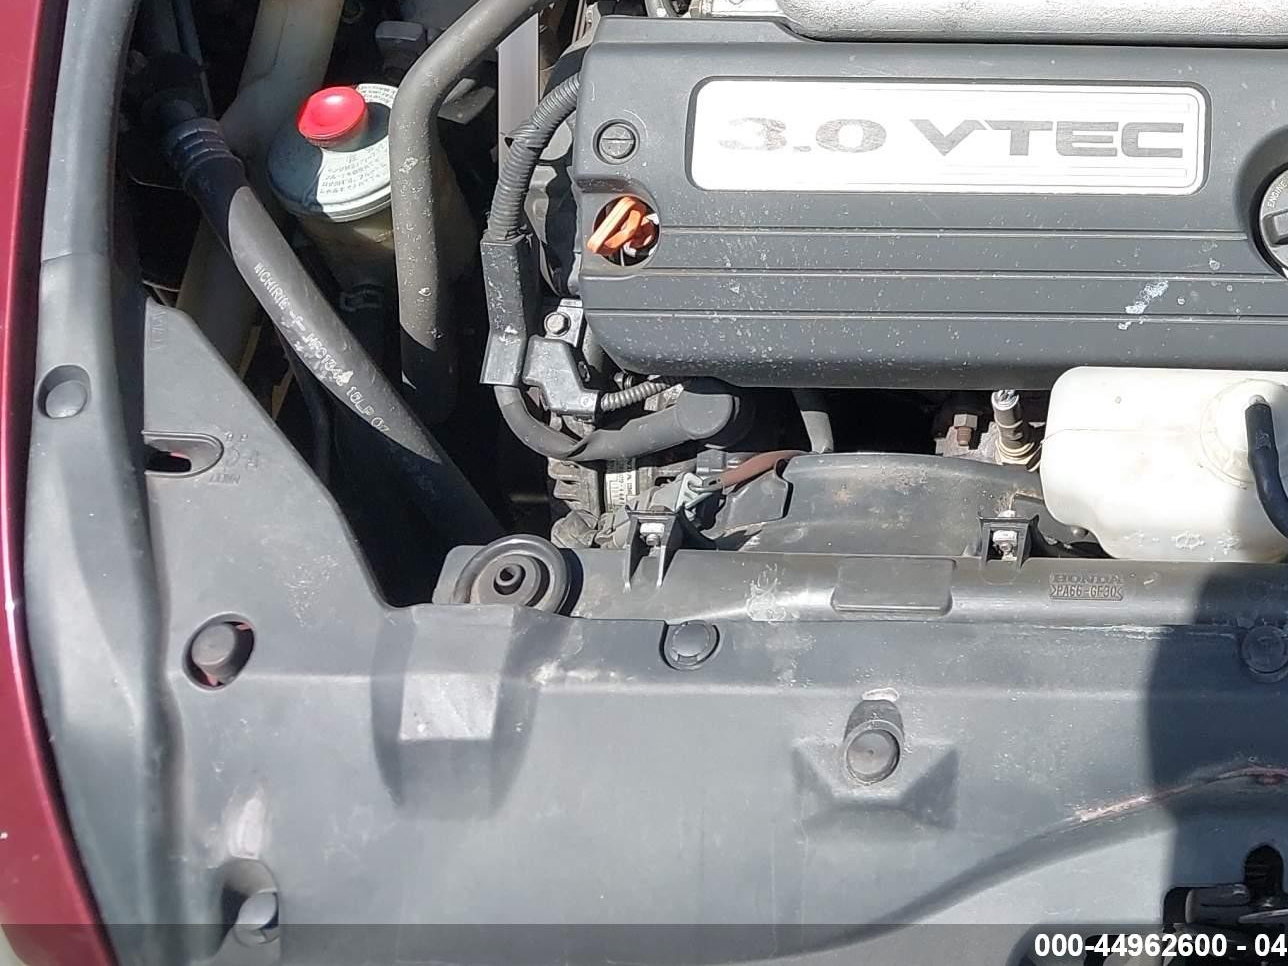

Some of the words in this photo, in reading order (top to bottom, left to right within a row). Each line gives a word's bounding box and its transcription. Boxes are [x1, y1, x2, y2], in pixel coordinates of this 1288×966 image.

[717, 116, 887, 154] 3.0
[909, 118, 1184, 158] VTEC
[1267, 180, 1288, 208] ENGINE
